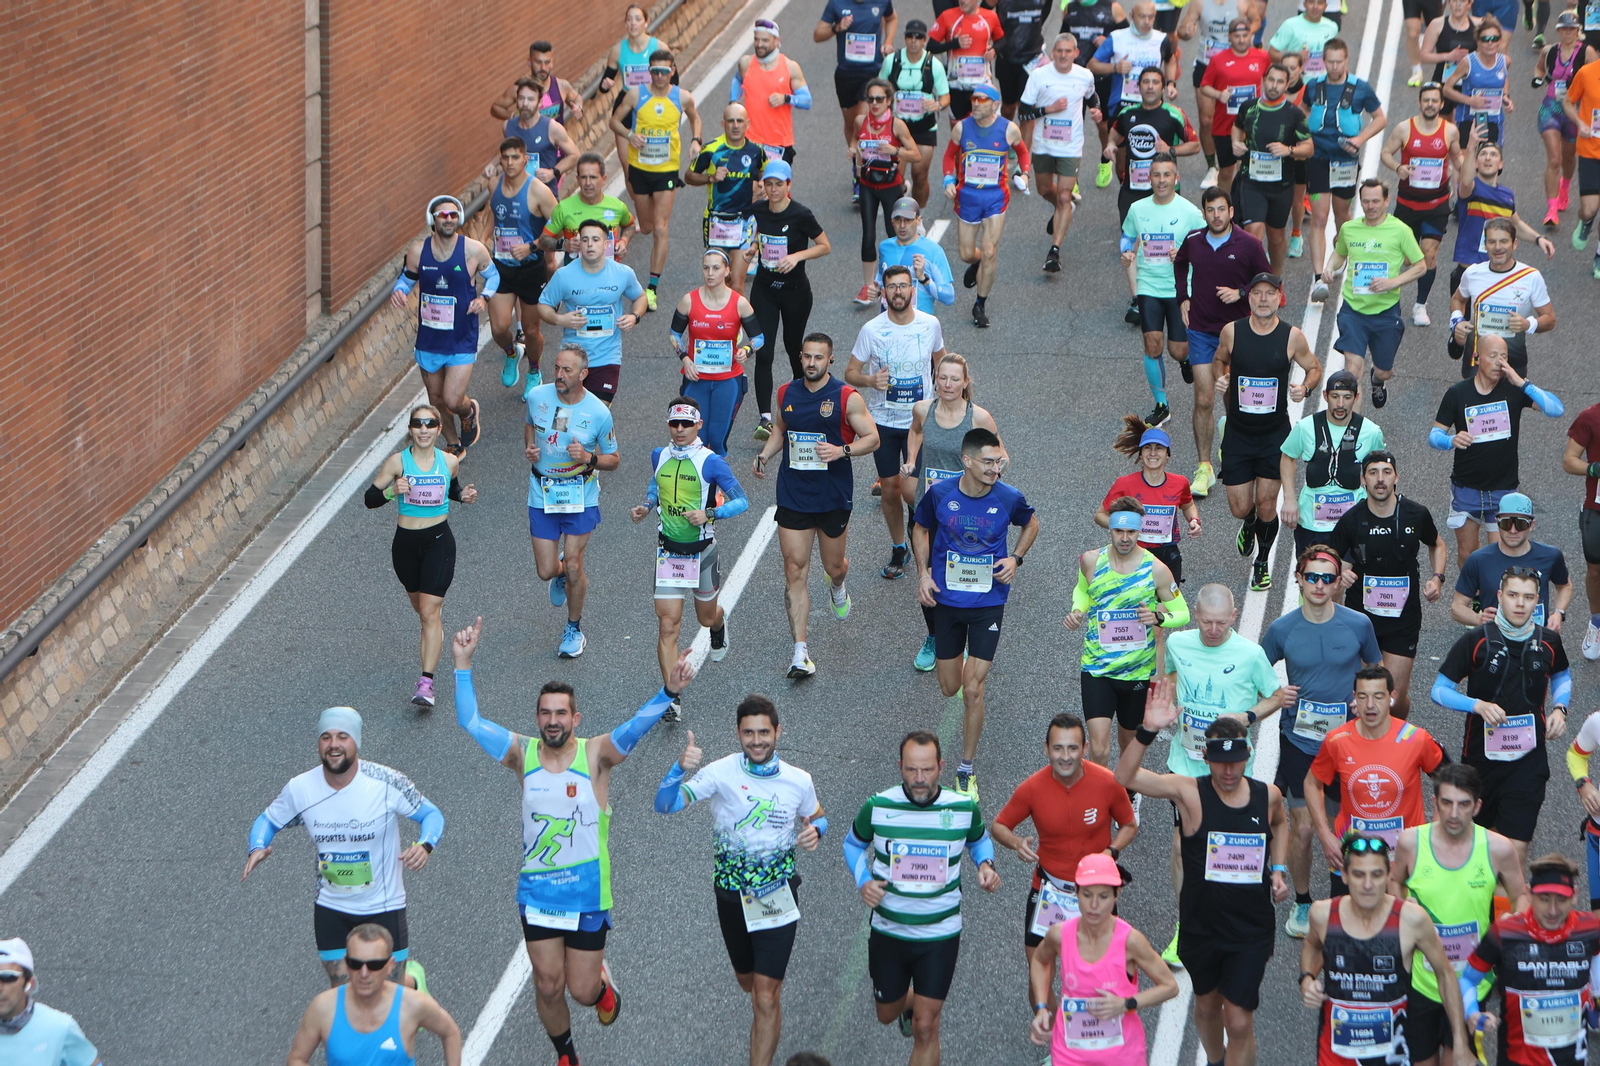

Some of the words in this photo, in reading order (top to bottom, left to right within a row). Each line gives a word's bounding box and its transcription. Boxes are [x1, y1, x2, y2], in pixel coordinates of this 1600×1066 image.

[899, 378, 919, 386] ZURICH
[1479, 404, 1502, 413] ZURICH
[799, 434, 820, 442] ZURICH
[1328, 495, 1350, 503] ZURICH
[668, 504, 687, 517] RAFA
[1315, 705, 1341, 713] ZURICH
[1502, 718, 1528, 727] ZURICH
[1368, 820, 1396, 829] ZURICH
[313, 834, 346, 843] DEPORTES
[350, 832, 375, 843] VARGAS
[1228, 837, 1258, 845] ZURICH
[911, 847, 941, 855] ZURICH
[335, 853, 364, 861] ZURICH
[911, 863, 928, 871] 7990
[1212, 862, 1239, 870] ANTONIO
[757, 880, 782, 897] ZURICH
[539, 907, 566, 916] REGALITO
[1441, 925, 1472, 935] ZURICH
[1518, 961, 1546, 970] SAN
[1549, 960, 1589, 971] PABLO
[1329, 971, 1353, 981] SAN
[1354, 973, 1397, 984] PABLO
[1541, 996, 1573, 1007] ZURICH
[1351, 1012, 1384, 1021] ZURICH
[1541, 1016, 1563, 1025] 11178
[1082, 1018, 1099, 1027] 8397
[1350, 1028, 1373, 1038] 11694
